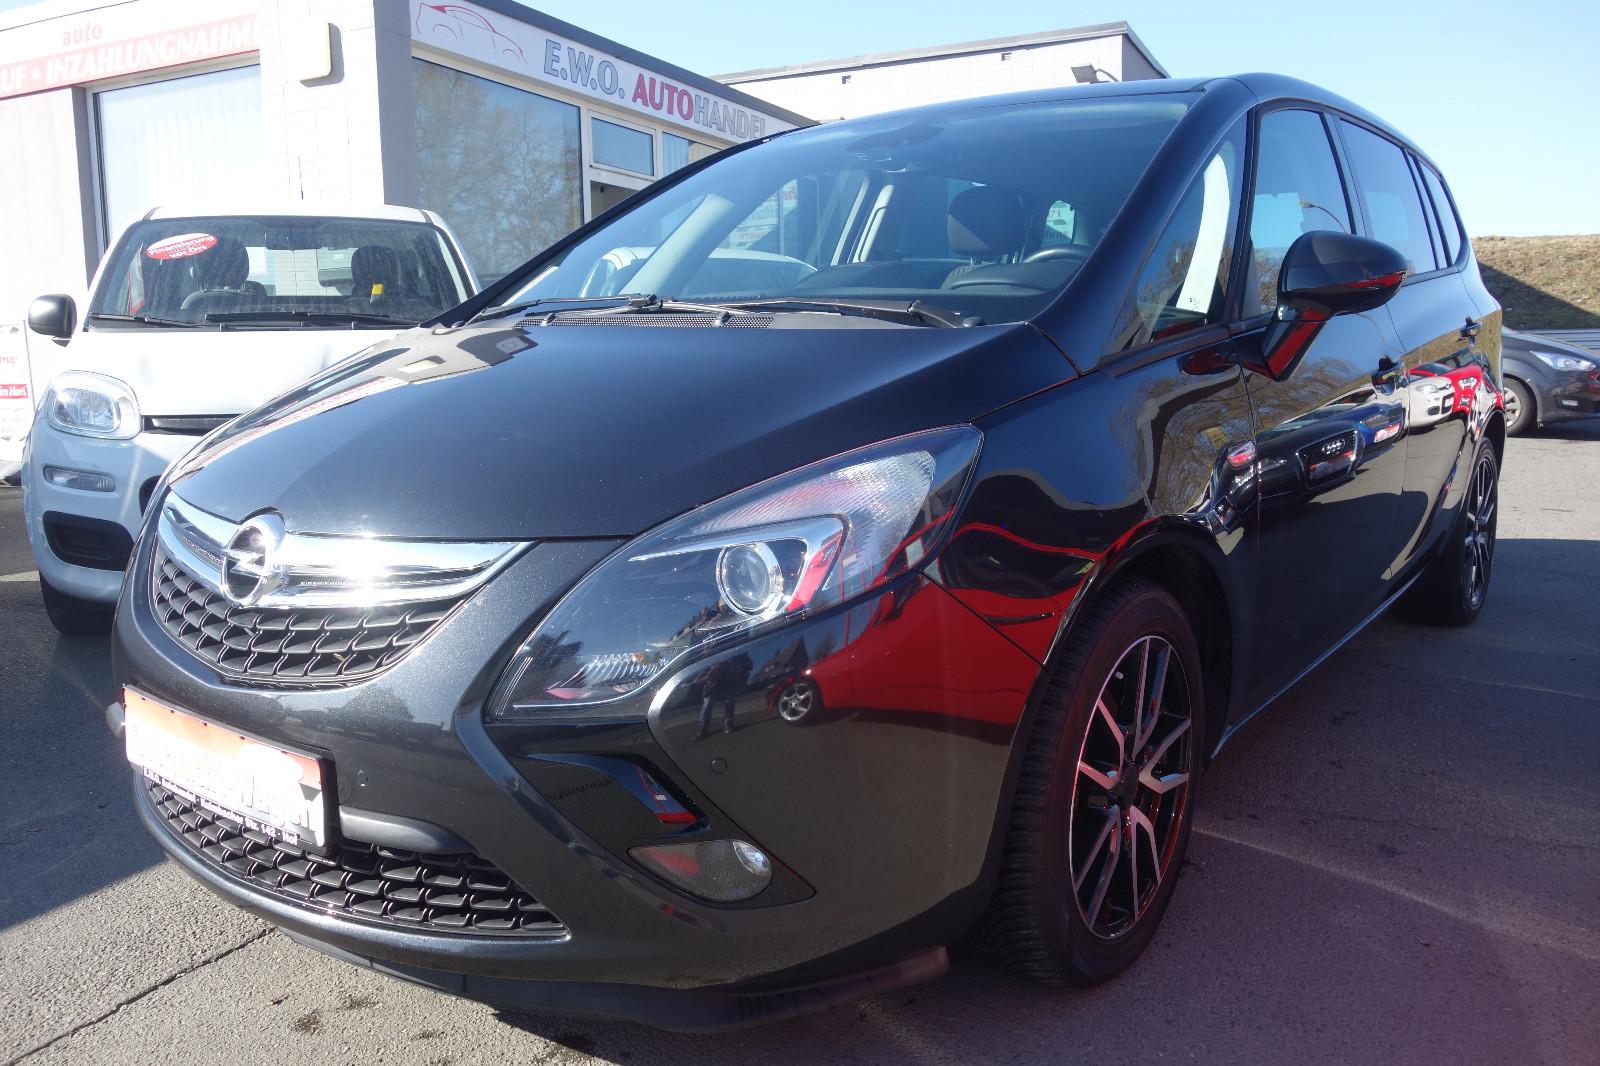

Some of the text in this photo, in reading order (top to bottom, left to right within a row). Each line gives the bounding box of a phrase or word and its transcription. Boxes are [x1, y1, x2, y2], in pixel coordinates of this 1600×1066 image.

[0, 20, 259, 92] UF INZAHLUNGNAHM
[62, 20, 103, 46] auto
[544, 38, 625, 99] E.W.O.
